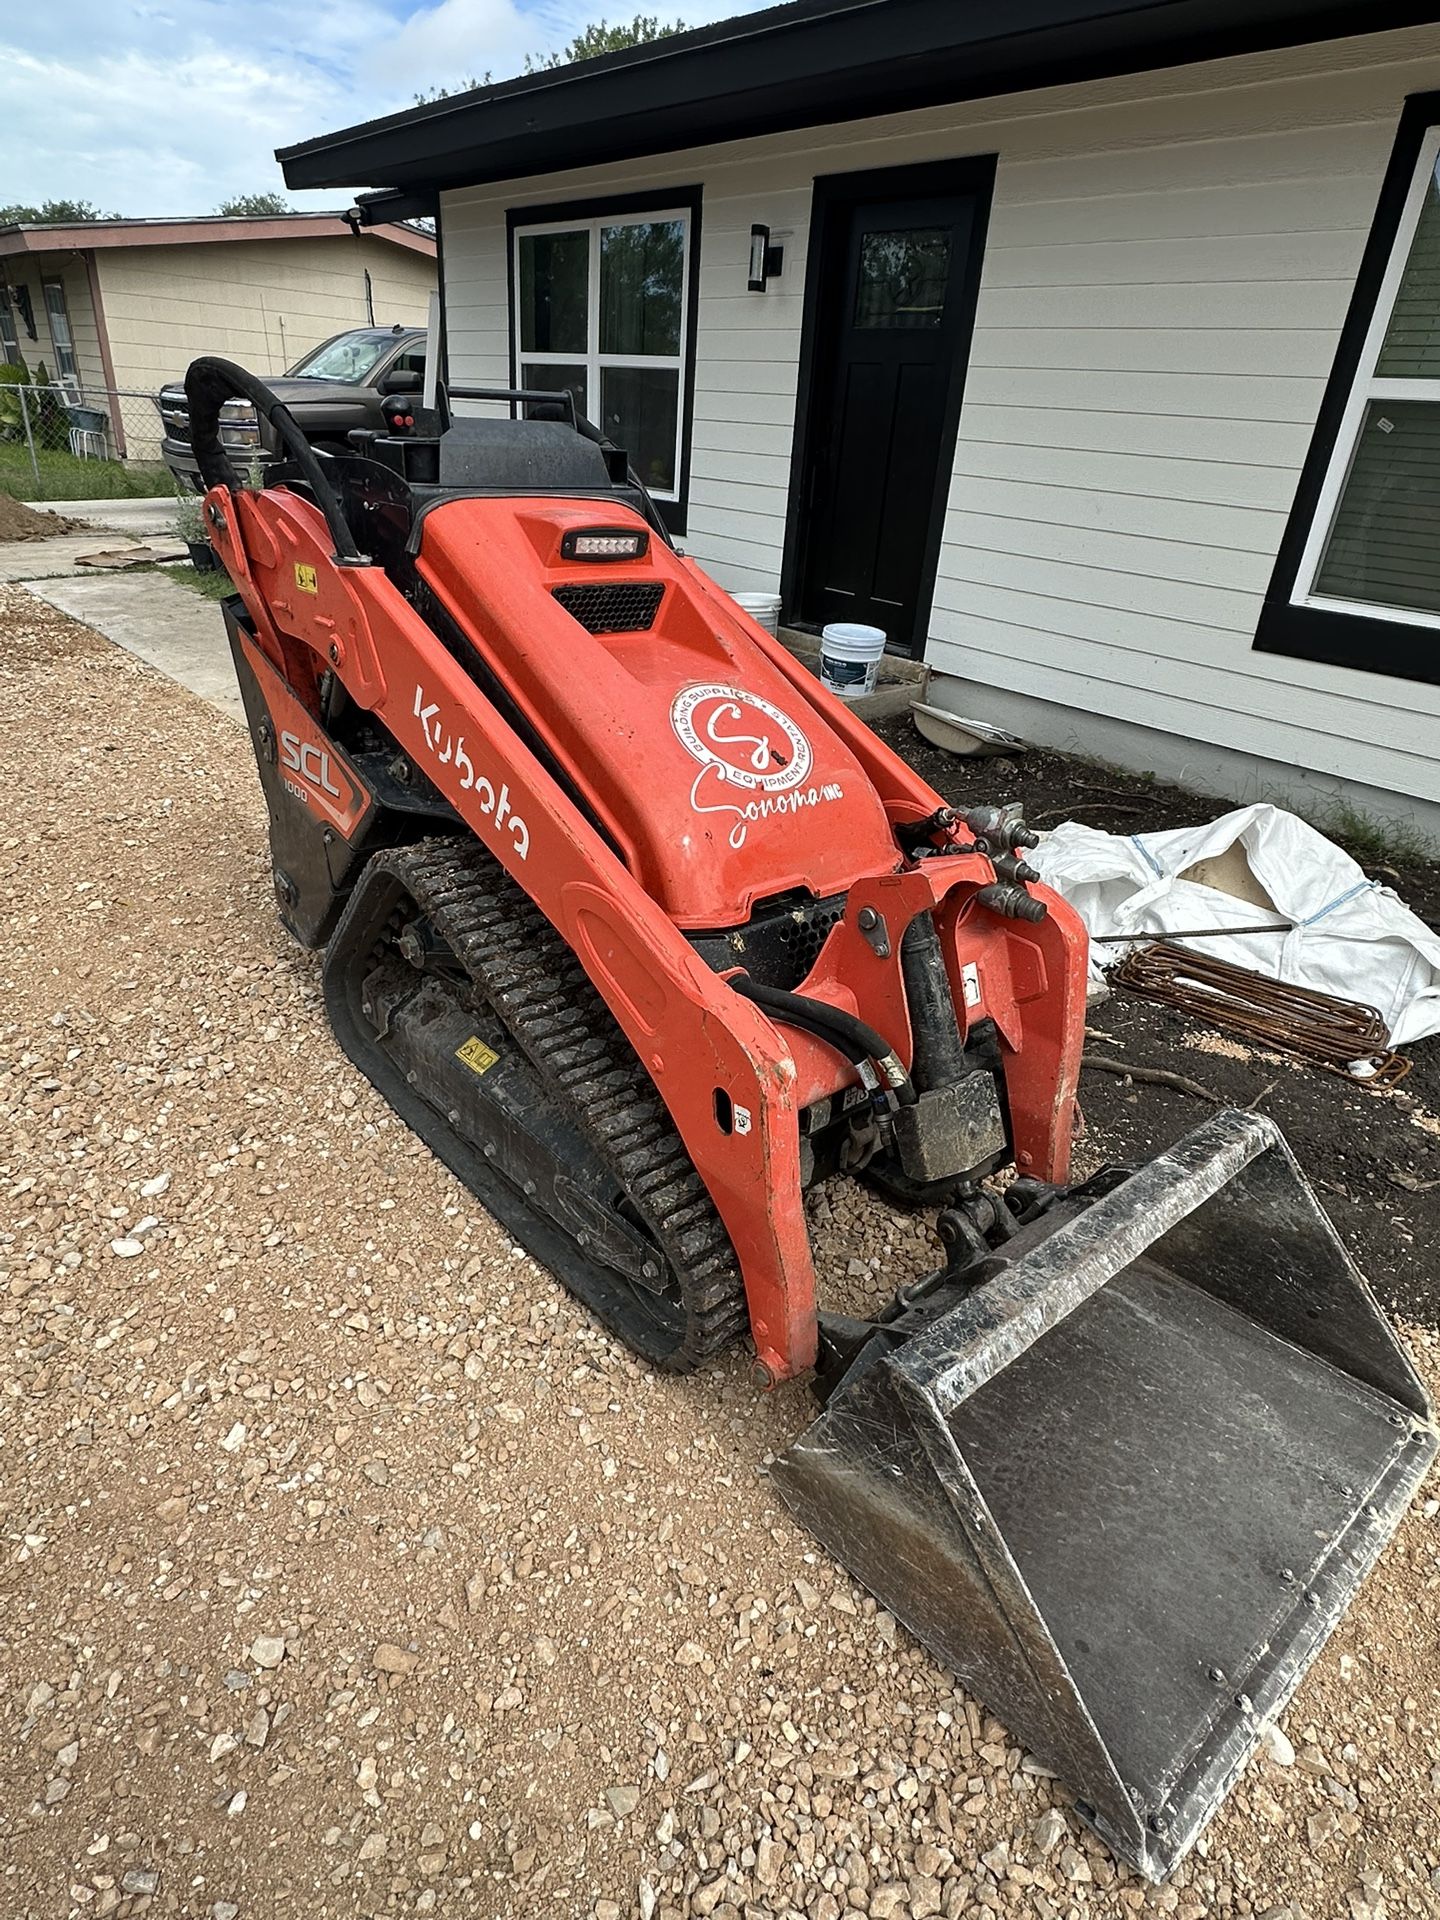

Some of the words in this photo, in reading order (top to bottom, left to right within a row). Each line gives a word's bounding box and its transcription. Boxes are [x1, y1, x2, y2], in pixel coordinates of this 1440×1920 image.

[281, 730, 341, 799] SCL
[283, 777, 308, 804] 1000
[413, 683, 530, 861] Kubota
[733, 762, 804, 788] EQUIPMENT
[690, 760, 823, 849] Sonoma
[822, 783, 844, 802] INC
